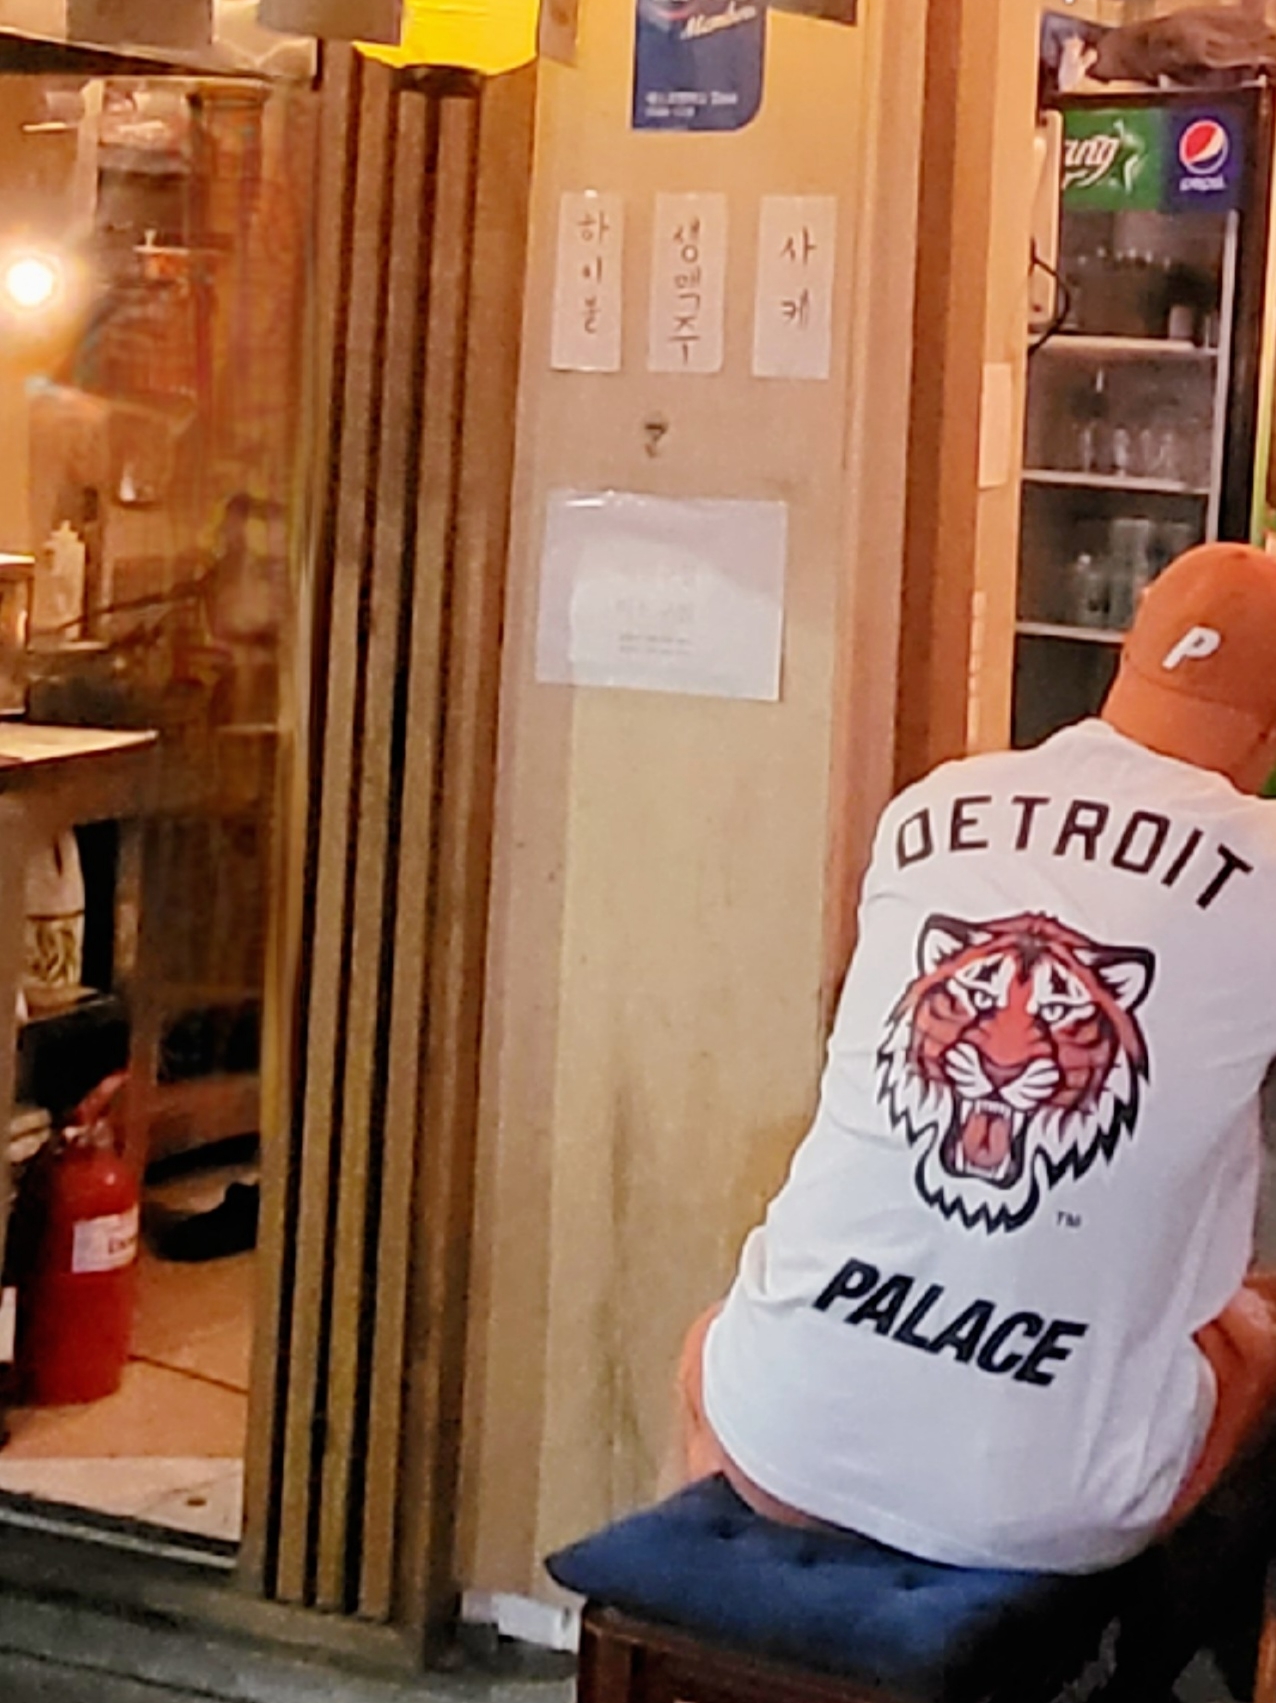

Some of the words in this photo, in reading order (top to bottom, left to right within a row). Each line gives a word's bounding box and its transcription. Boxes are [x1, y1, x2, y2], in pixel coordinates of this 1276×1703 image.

[668, 216, 702, 365] 생맥주
[779, 225, 818, 331] 사케
[1161, 625, 1222, 671] P
[897, 795, 1254, 910] DETROIT
[812, 1257, 1088, 1388] PALACE
